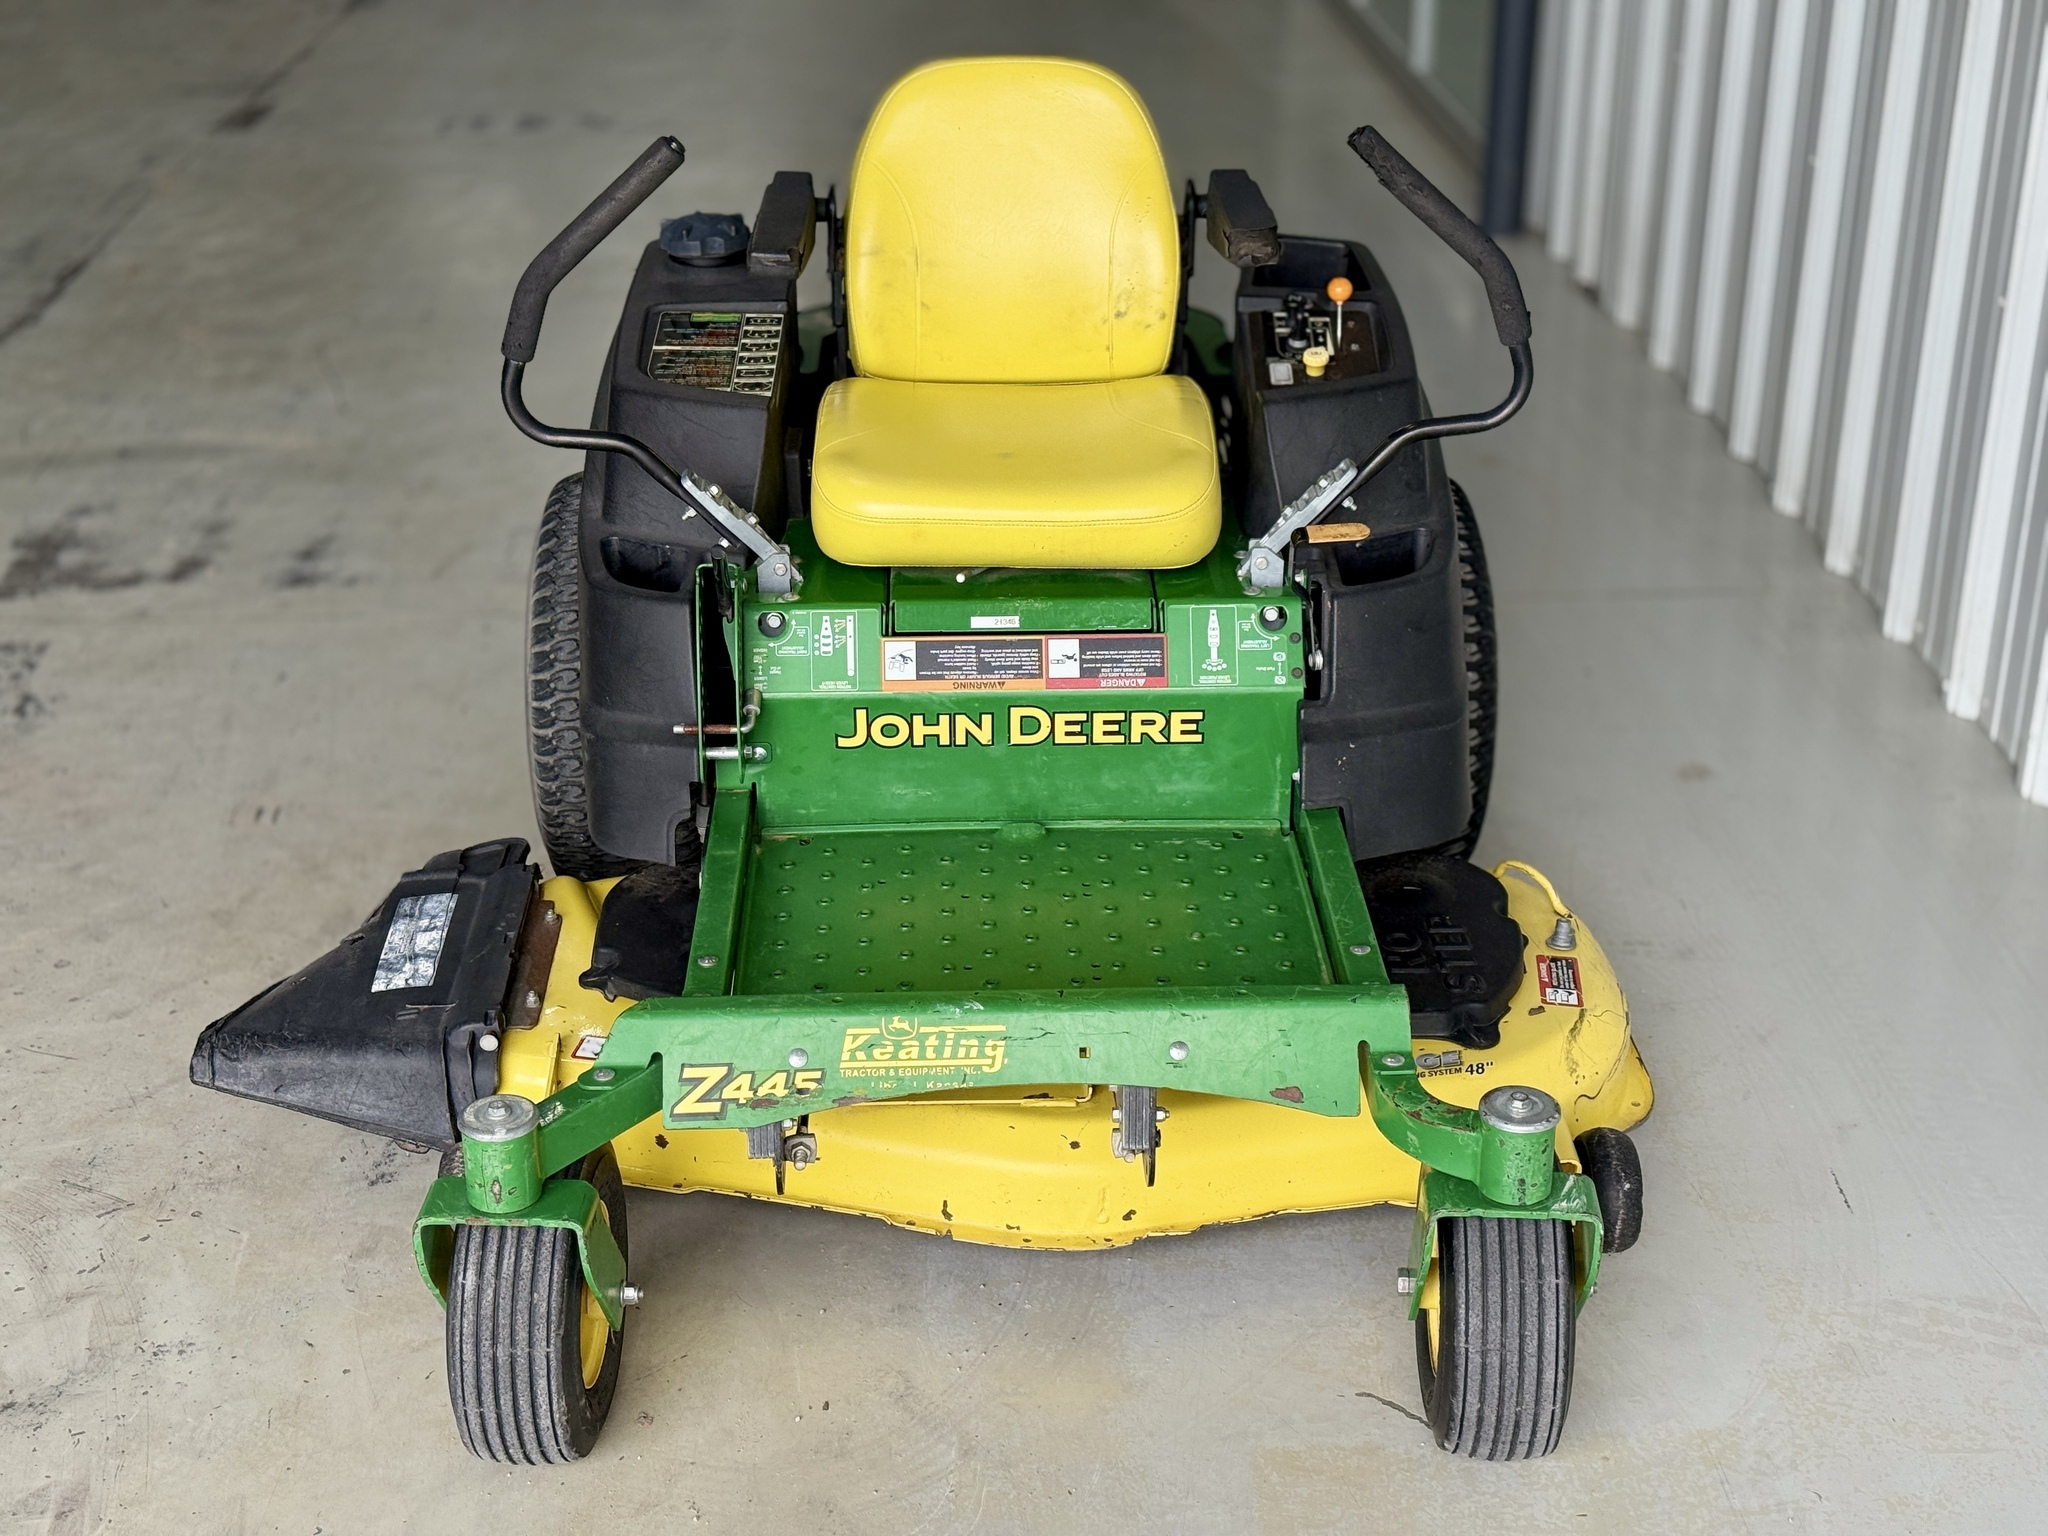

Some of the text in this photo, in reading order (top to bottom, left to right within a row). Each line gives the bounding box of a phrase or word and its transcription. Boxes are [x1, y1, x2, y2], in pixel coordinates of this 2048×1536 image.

[952, 681, 997, 690] WARNING
[1100, 678, 1136, 687] DANGER
[840, 1031, 1006, 1073] Keating
[840, 1068, 885, 1077] TRACTOR
[890, 1068, 896, 1076] &
[900, 1067, 956, 1077] EQUIPMENT
[1427, 1067, 1462, 1077] SYSTEM
[670, 1063, 826, 1119] Z445
